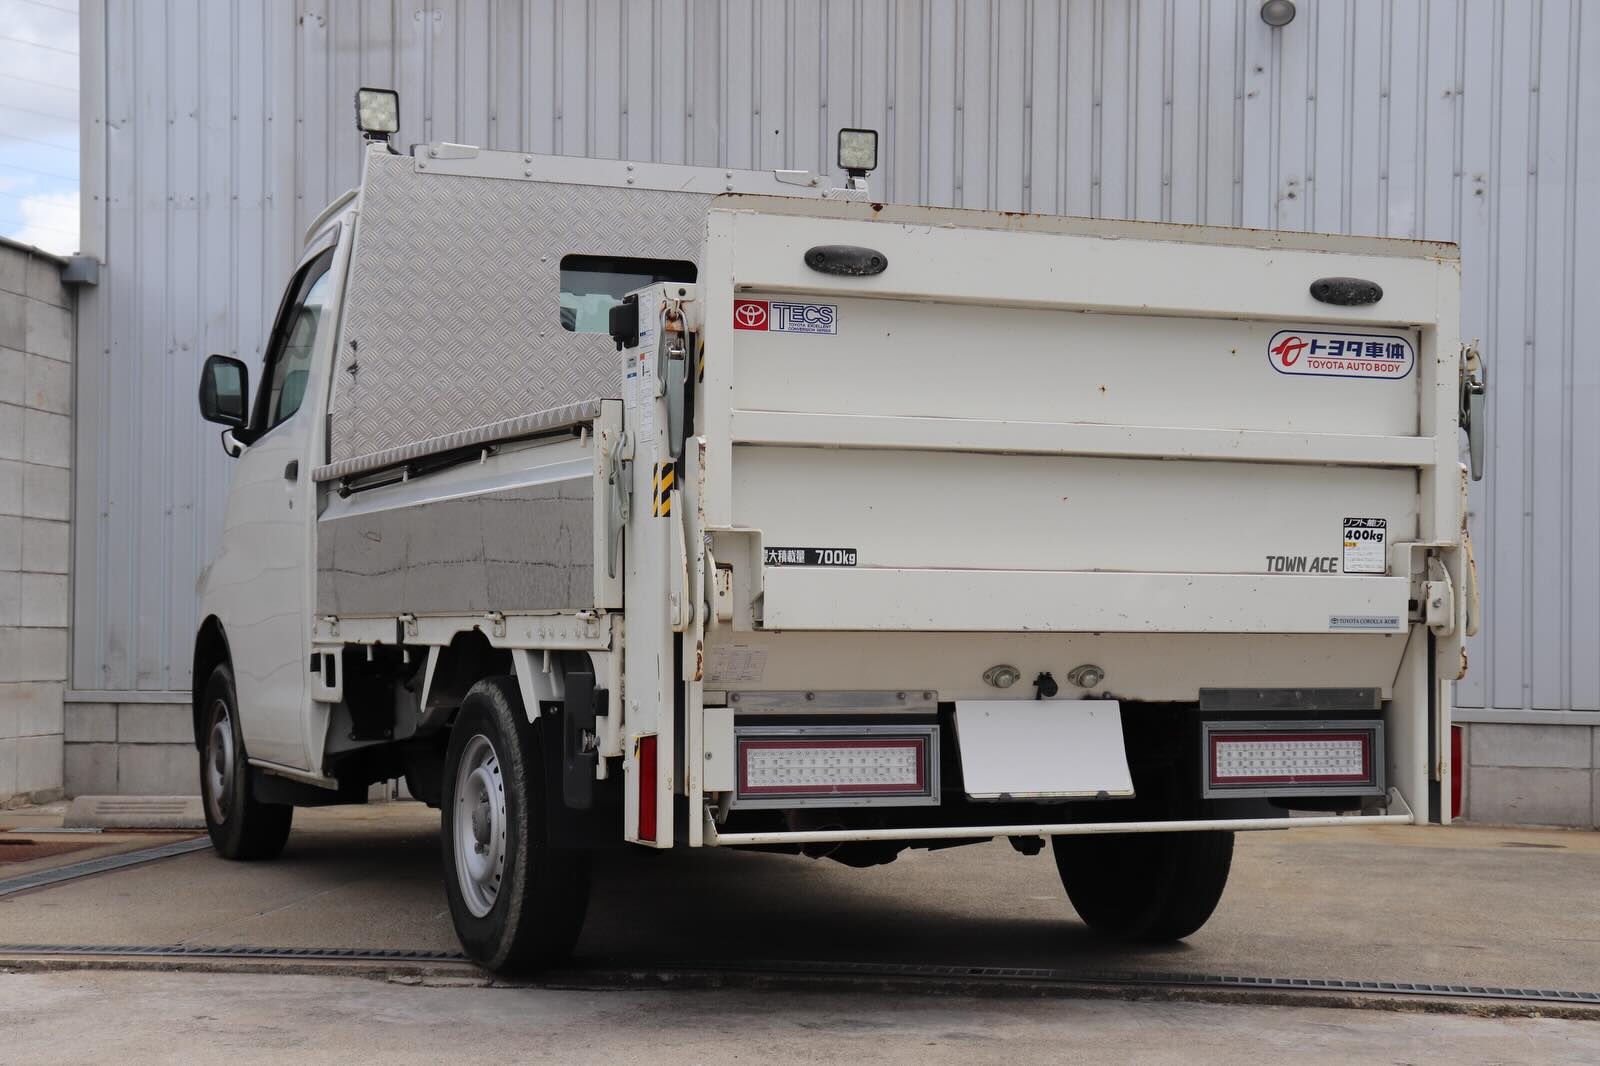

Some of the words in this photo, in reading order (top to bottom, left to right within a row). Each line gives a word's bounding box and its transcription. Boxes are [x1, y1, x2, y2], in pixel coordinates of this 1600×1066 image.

[772, 303, 833, 330] TECS
[1310, 339, 1405, 360] トヨタ車体
[1307, 360, 1344, 370] TOYOTA
[1346, 361, 1373, 372] AUTO
[1374, 363, 1400, 373] BODY
[1344, 518, 1386, 528] リフト能力
[1345, 530, 1384, 542] 400kg
[815, 550, 856, 564] 700kg
[1266, 556, 1307, 572] TOWN
[1308, 556, 1338, 573] ACE
